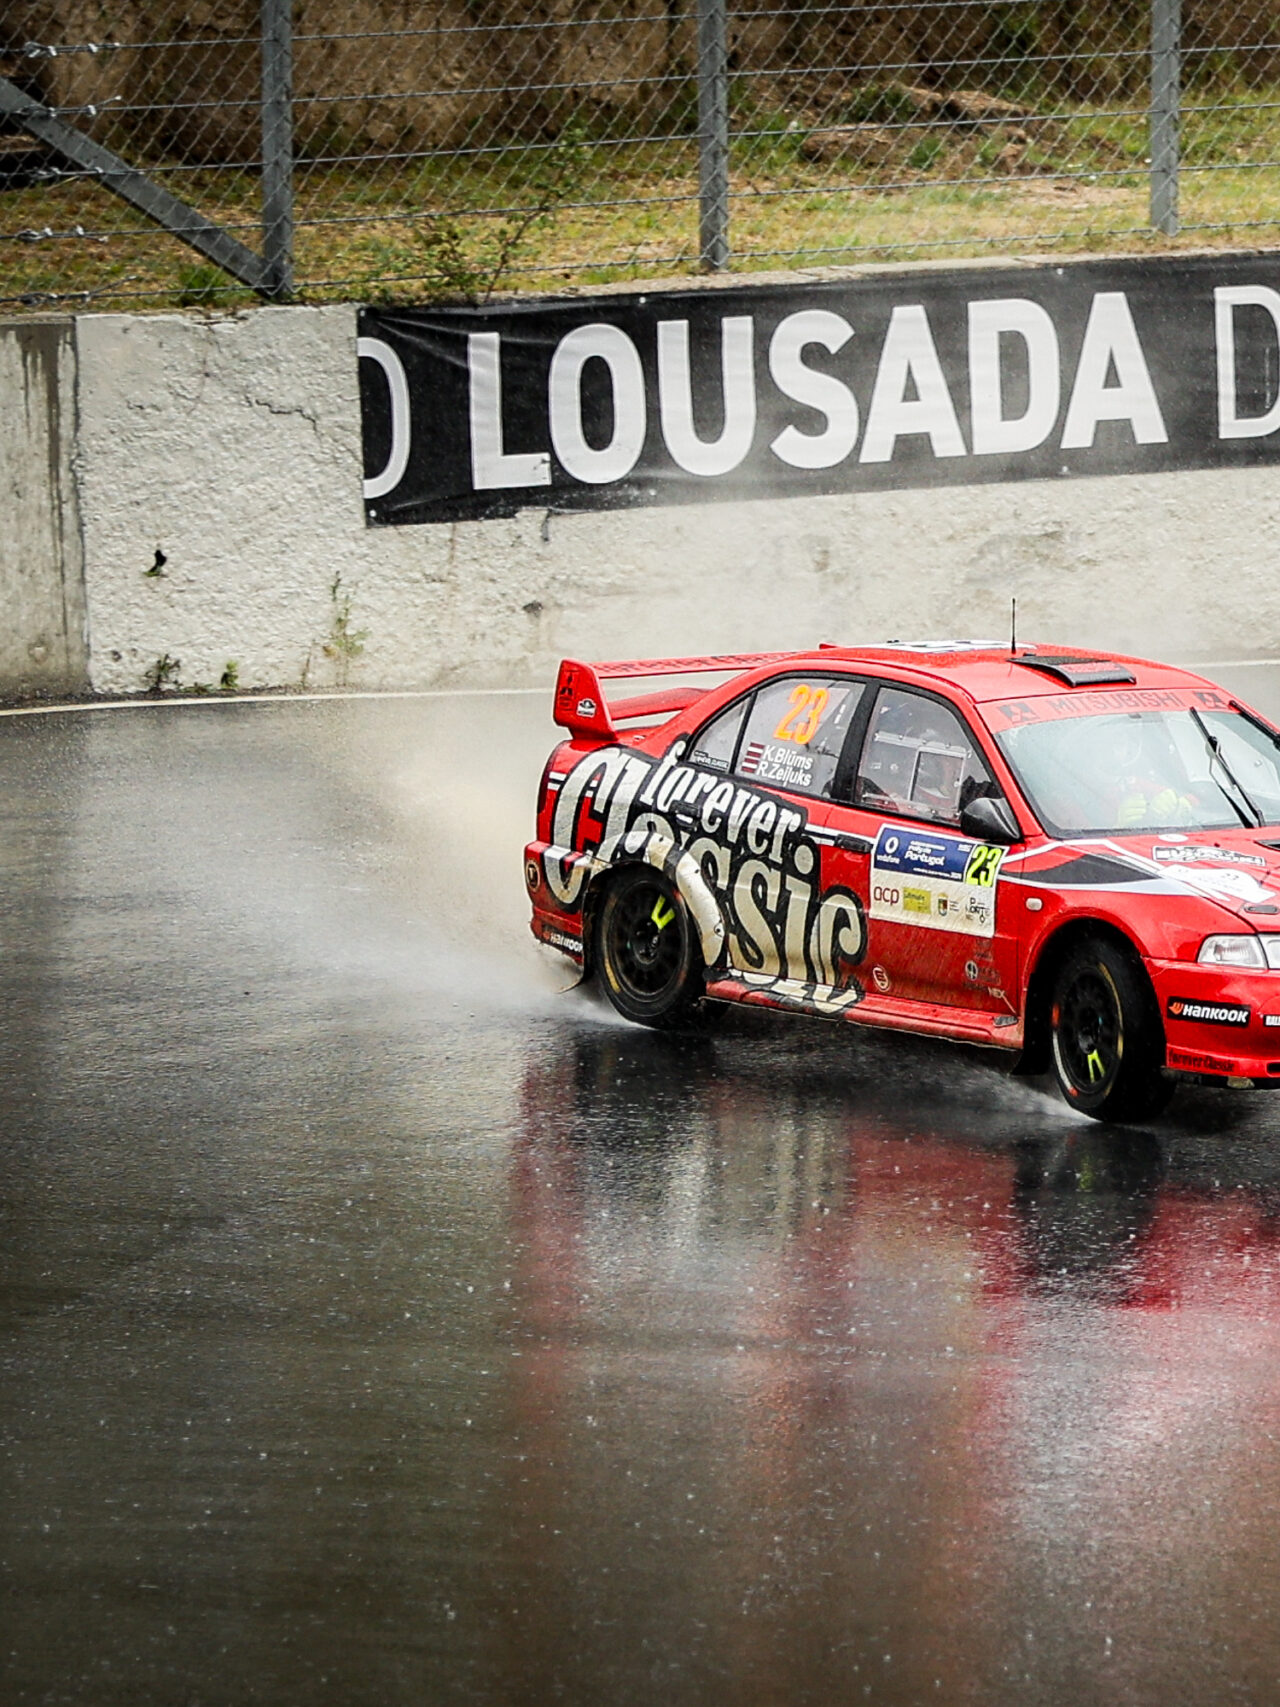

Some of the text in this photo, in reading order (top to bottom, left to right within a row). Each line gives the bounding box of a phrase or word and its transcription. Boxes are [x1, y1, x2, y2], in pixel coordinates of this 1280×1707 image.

[468, 291, 1168, 490] LOUSADA
[773, 683, 830, 745] 23
[1047, 691, 1186, 715] MITSUBISHI
[640, 739, 802, 865] forever
[965, 845, 1003, 888] 23
[873, 886, 900, 906] acp
